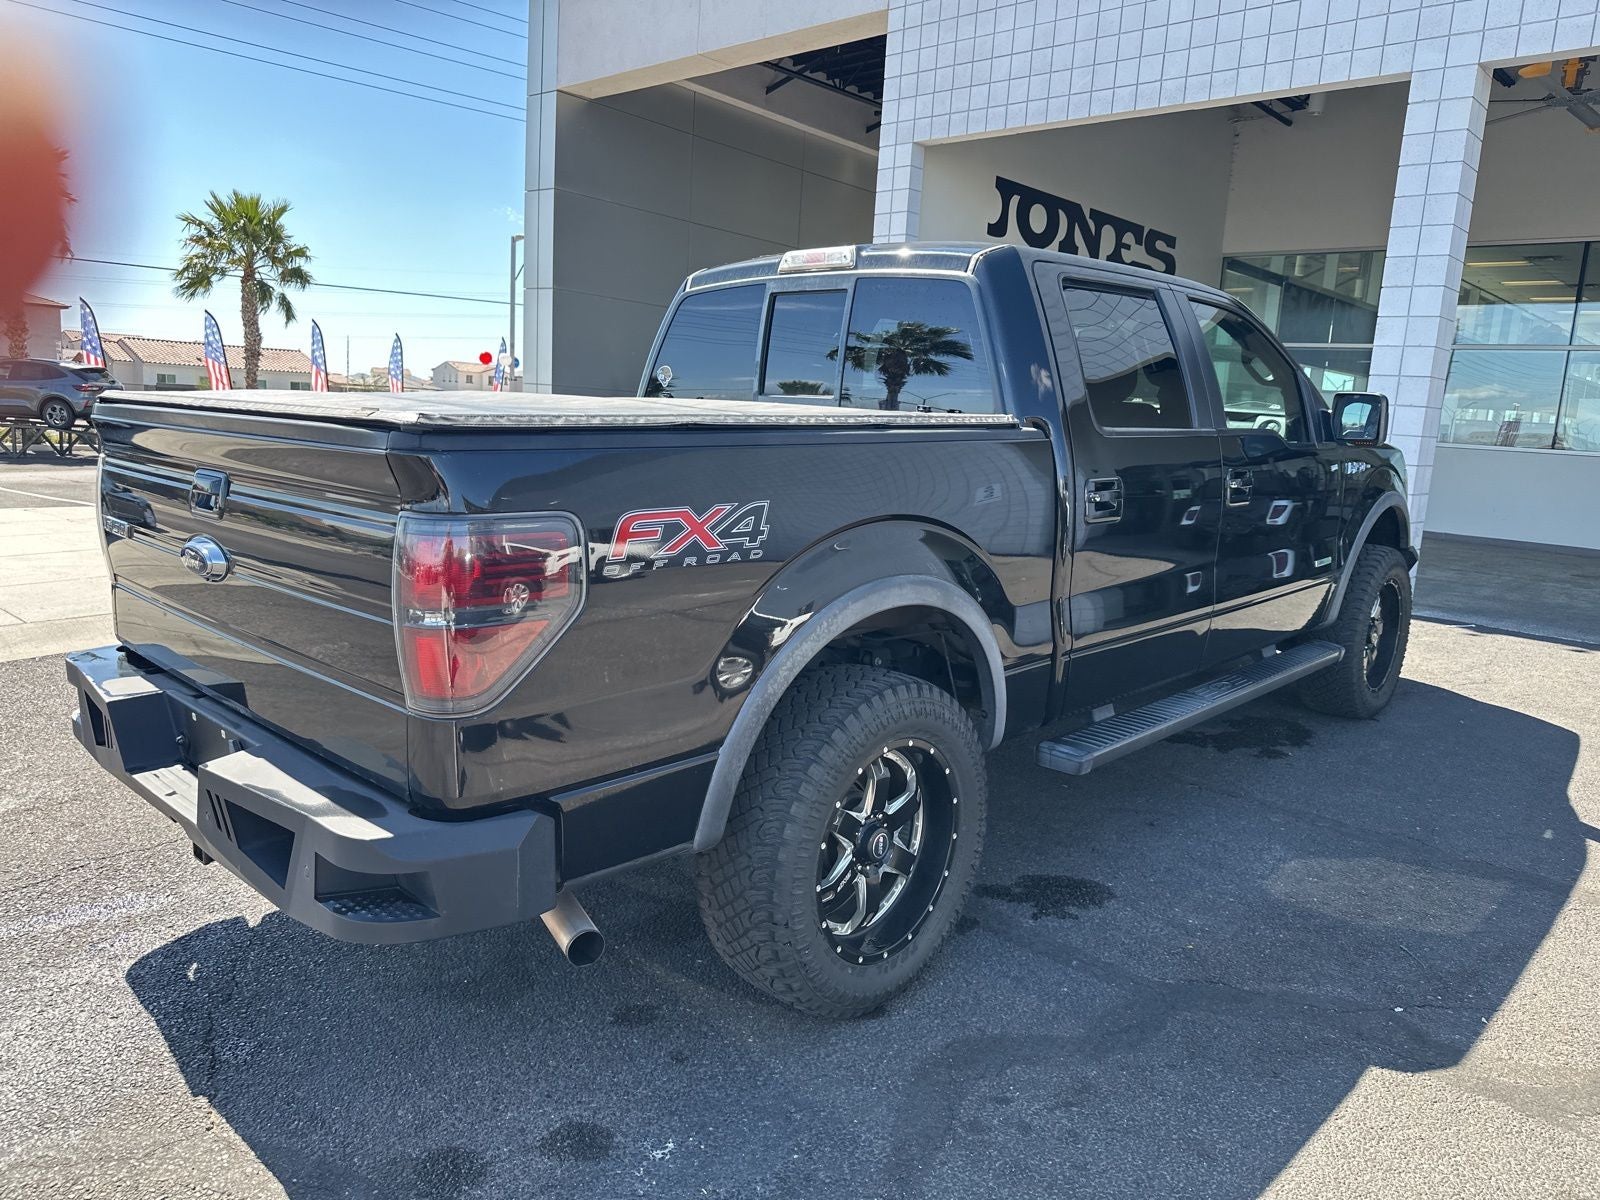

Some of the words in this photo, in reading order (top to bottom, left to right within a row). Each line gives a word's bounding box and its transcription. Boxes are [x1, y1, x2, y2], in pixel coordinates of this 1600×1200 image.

[986, 175, 1177, 276] JONES
[603, 559, 669, 575] OFF
[682, 550, 764, 567] ROAD
[606, 500, 770, 563] FX4
